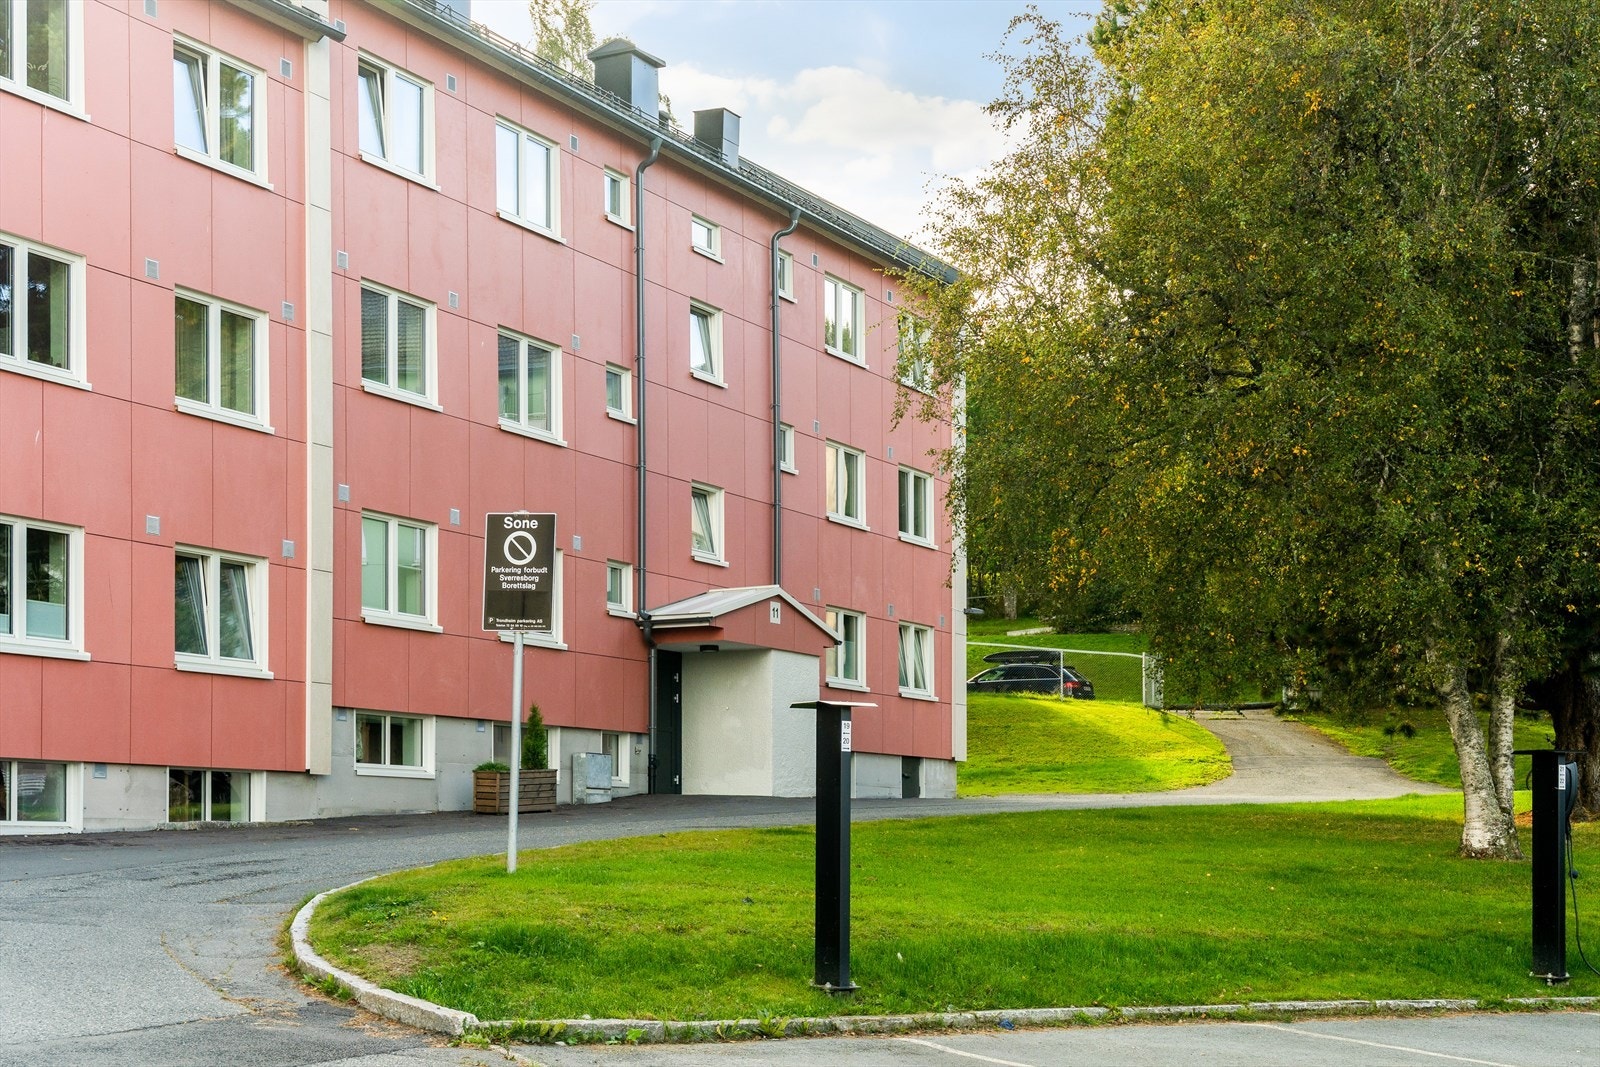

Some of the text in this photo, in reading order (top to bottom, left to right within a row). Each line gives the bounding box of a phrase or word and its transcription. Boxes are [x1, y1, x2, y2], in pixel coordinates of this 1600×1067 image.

[503, 516, 539, 529] Sone
[491, 566, 548, 575] Parkering forbudt
[499, 574, 540, 582] Sverresborg
[502, 582, 536, 590] Borettslag
[772, 607, 779, 619] 11
